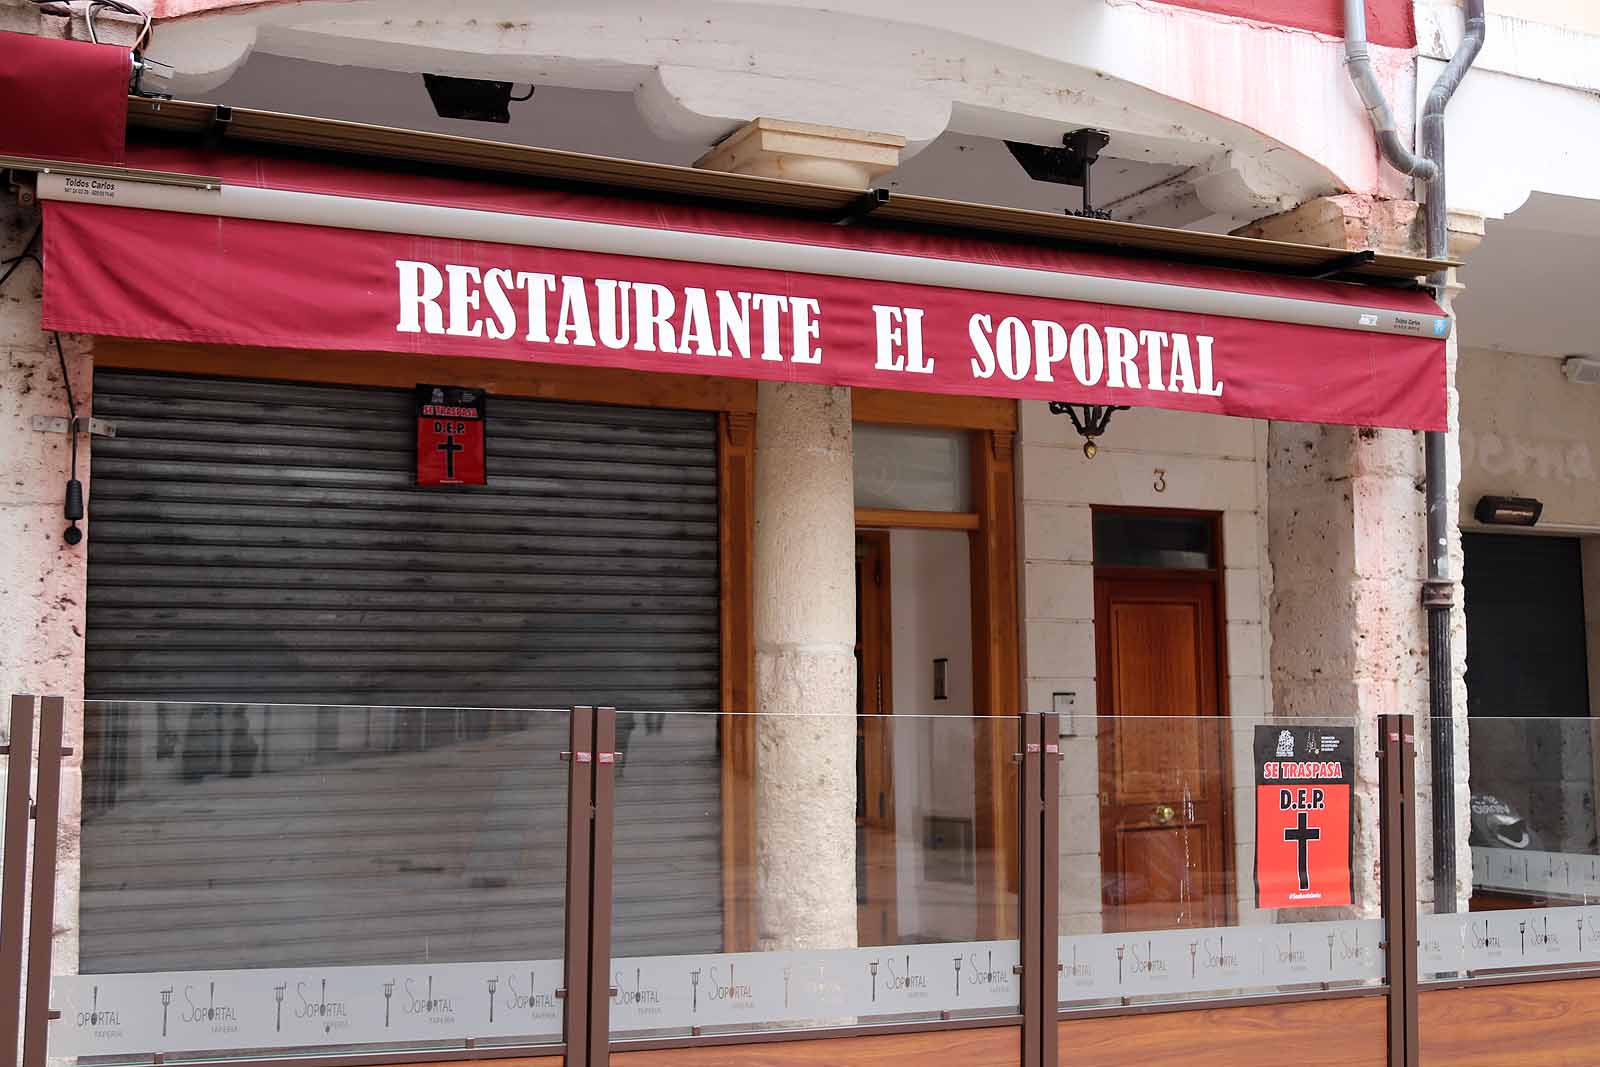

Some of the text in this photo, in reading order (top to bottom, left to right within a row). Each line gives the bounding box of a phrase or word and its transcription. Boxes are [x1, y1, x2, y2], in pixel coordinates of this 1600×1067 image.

[65, 178, 115, 190] Toldos Carlos
[395, 260, 1224, 397] RESTAURANTE EL SOPORTAL
[1153, 468, 1166, 493] 3
[1264, 761, 1343, 779] SE TRASPASA
[181, 982, 238, 1024] SOPORTAL
